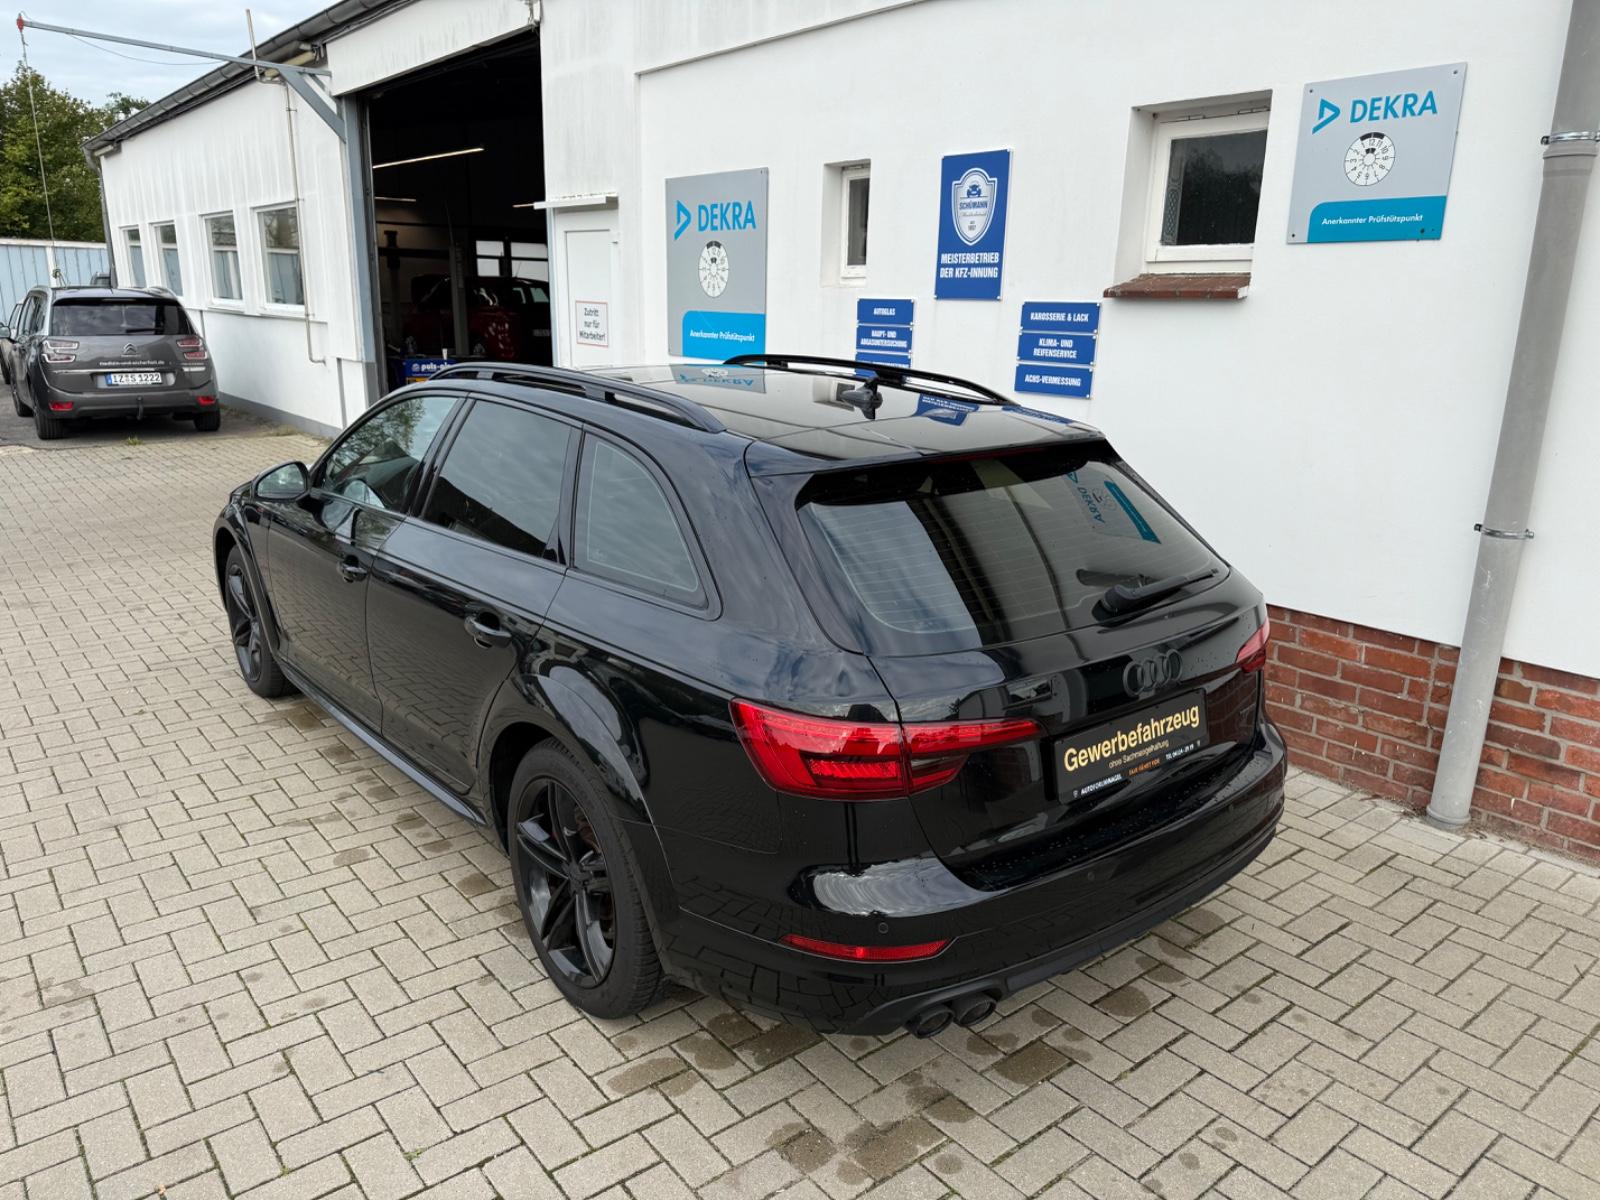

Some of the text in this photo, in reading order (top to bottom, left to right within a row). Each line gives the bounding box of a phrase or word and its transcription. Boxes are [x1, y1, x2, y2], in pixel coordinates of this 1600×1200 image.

[1349, 90, 1438, 124] DEKRA
[697, 199, 757, 232] DEKRA
[1321, 213, 1424, 226] Anerkannter Prüfstützpunkt
[940, 252, 1000, 265] MEISTERBETRIEB
[939, 267, 999, 279] DER KFZ-INNUNG
[584, 306, 599, 317] Zutritt
[1030, 311, 1089, 323] KAROSSERIE & LACK
[689, 329, 719, 339] Anerkannter
[1038, 337, 1073, 349] KLIMA- UND
[1033, 347, 1078, 359] REIFENSERVICE
[139, 373, 160, 382] 1222
[1024, 373, 1082, 387] ACHS-VERMESSUNG
[1063, 705, 1200, 772] Gewerbefahrzeug
